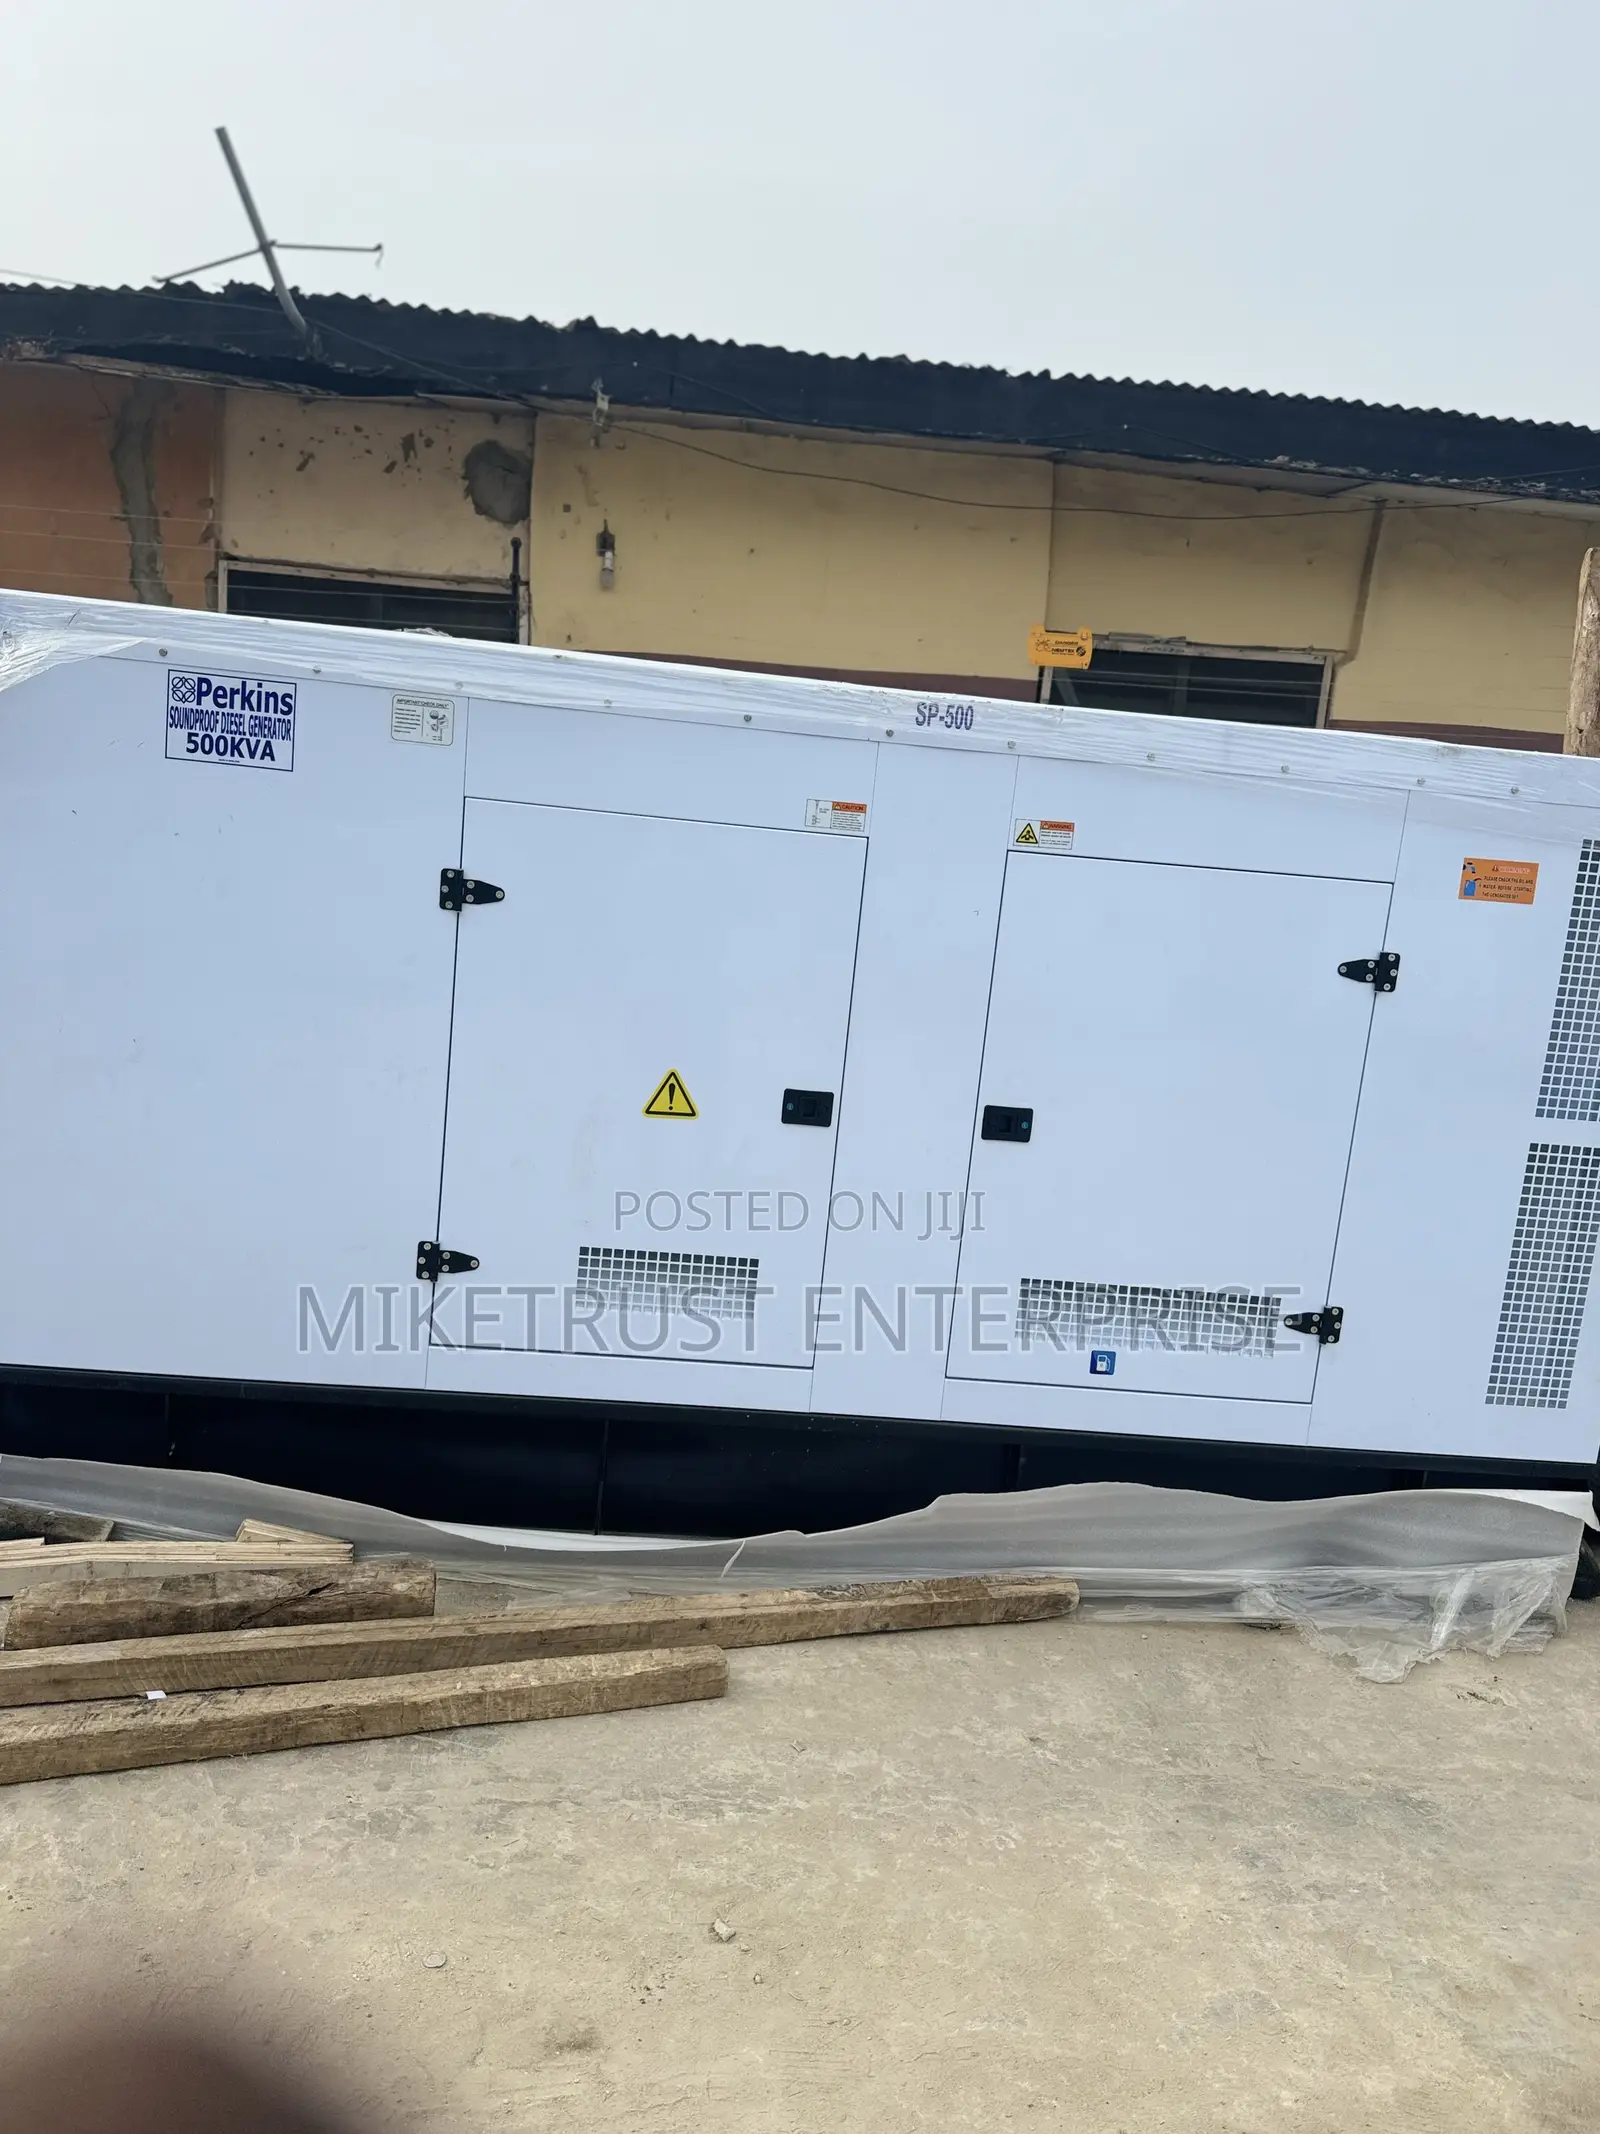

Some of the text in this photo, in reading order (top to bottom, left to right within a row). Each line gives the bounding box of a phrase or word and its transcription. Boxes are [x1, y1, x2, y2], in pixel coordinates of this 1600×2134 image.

[196, 676, 293, 716] Perkins
[169, 705, 292, 741] SOUNDPROOF DIESEL GENERATOR
[915, 702, 974, 730] SP-500
[186, 732, 276, 762] 500KVA
